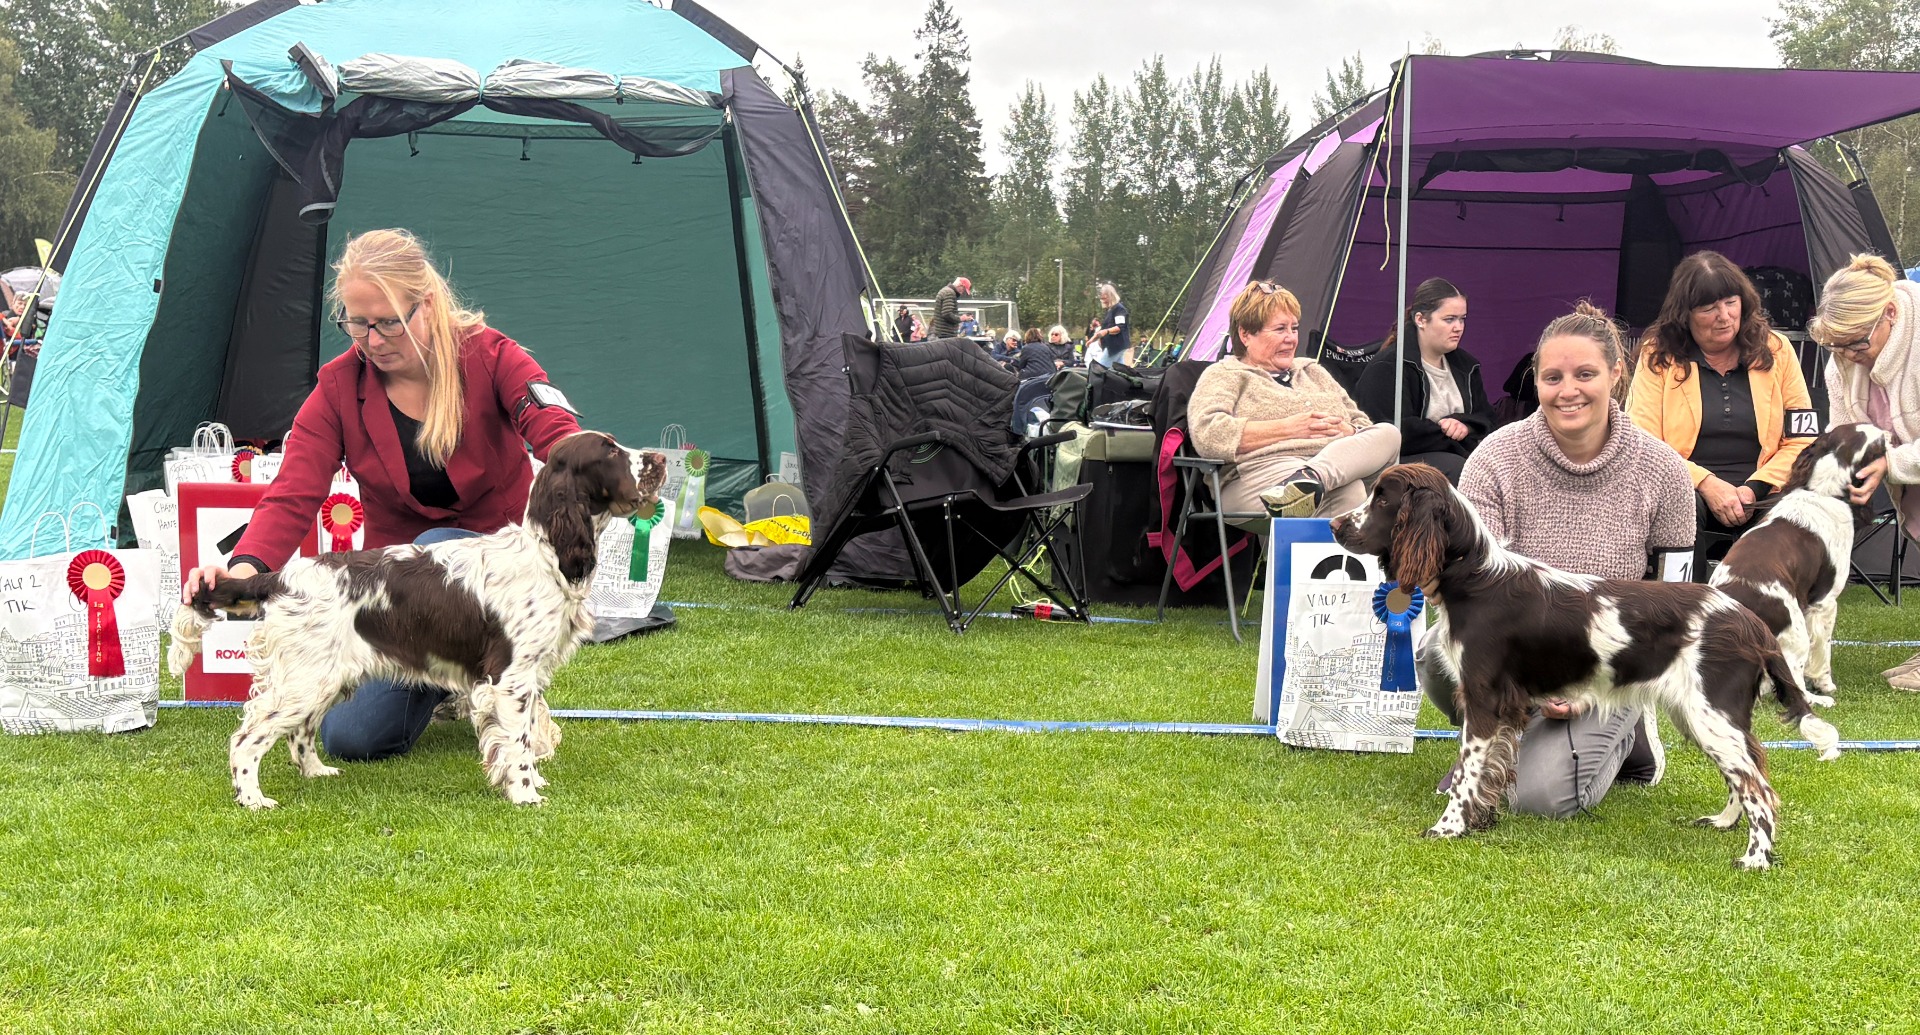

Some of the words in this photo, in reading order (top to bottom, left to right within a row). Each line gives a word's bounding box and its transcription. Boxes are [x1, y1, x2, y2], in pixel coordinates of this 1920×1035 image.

[1794, 413, 1816, 433] 12
[29, 574, 42, 588] 2
[1340, 592, 1351, 604] 2
[3, 599, 36, 613] TIK
[1308, 613, 1335, 628] TIK
[215, 649, 248, 660] ROYA
